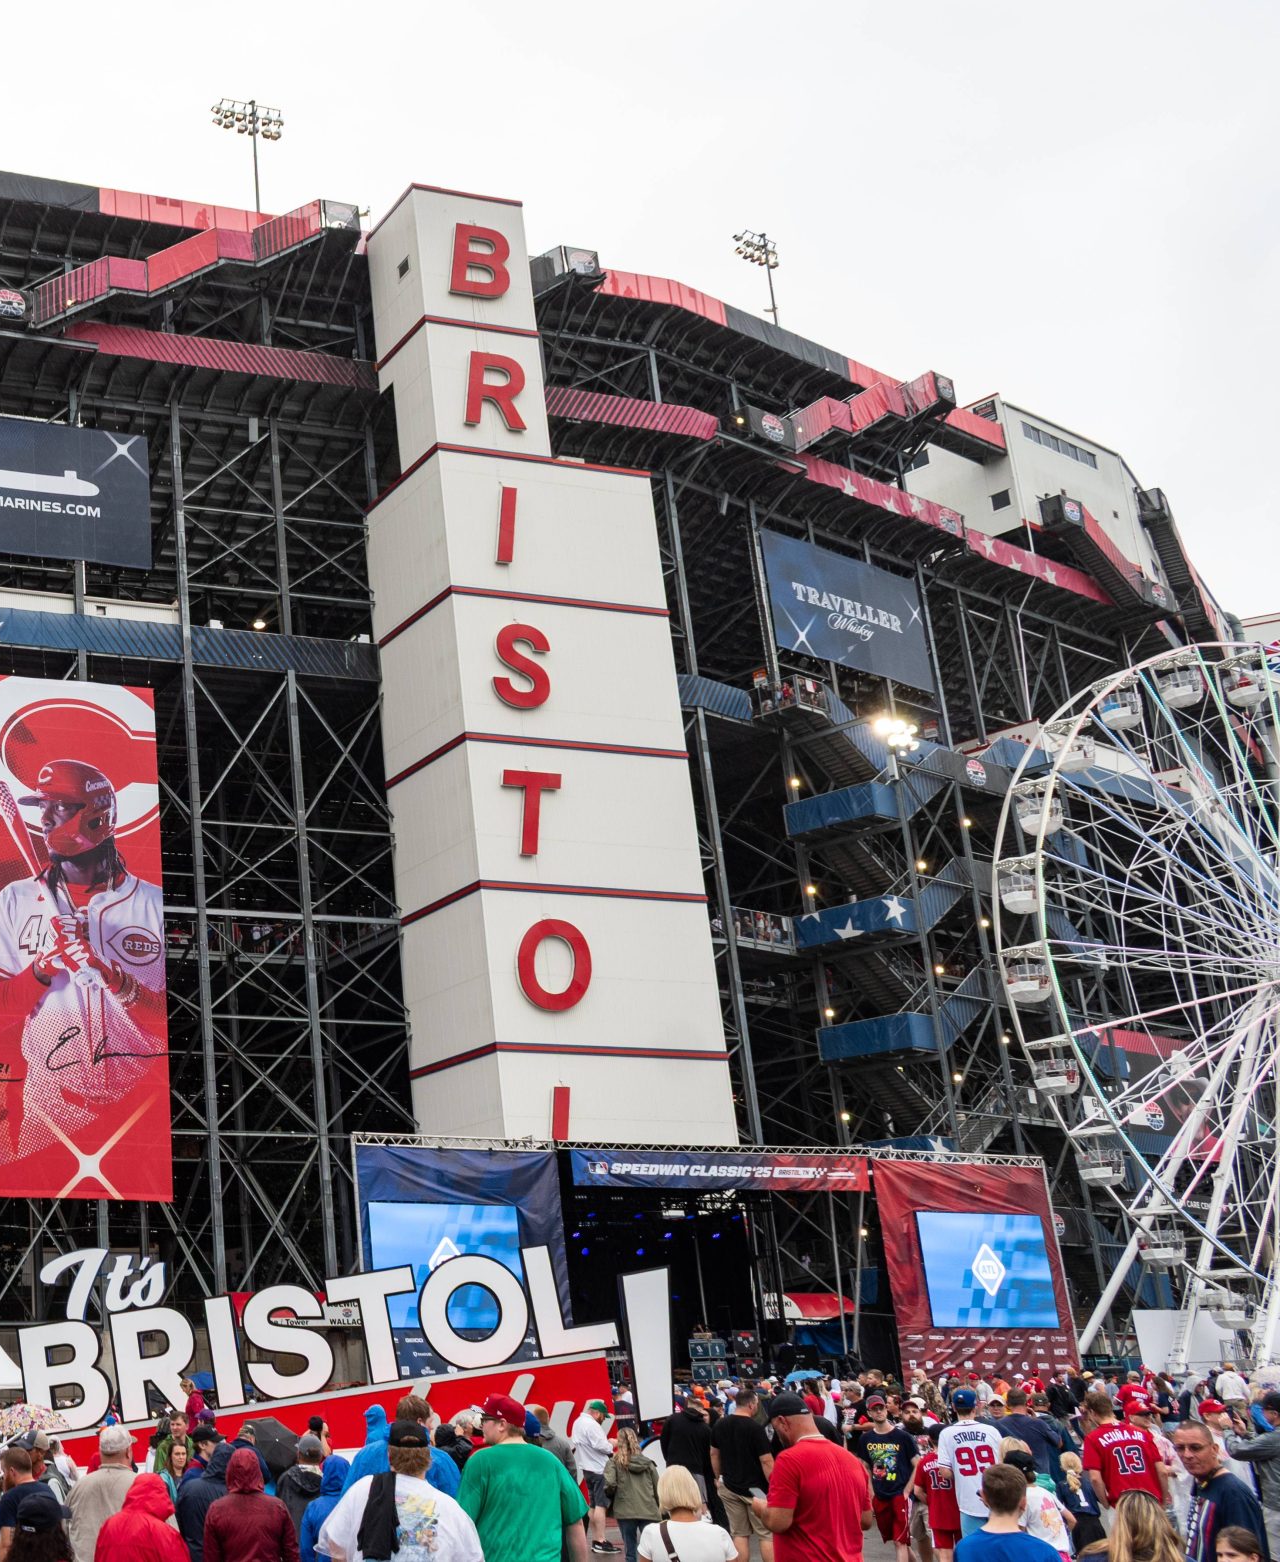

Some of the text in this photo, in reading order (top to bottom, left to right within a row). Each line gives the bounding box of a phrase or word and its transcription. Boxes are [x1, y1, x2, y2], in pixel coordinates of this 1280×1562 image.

[791, 581, 904, 634] TRAVELLER
[827, 612, 875, 642] Whiskey
[124, 940, 159, 953] REDS
[610, 1163, 688, 1176] SPEEDWAY
[689, 1165, 752, 1178] CLASSIC
[39, 1248, 166, 1321] It's
[866, 1443, 900, 1451] GORDON
[953, 1431, 987, 1445] STRIDER
[1098, 1428, 1131, 1447] ACUÑA
[955, 1445, 996, 1476] 99
[1113, 1445, 1146, 1474] 13
